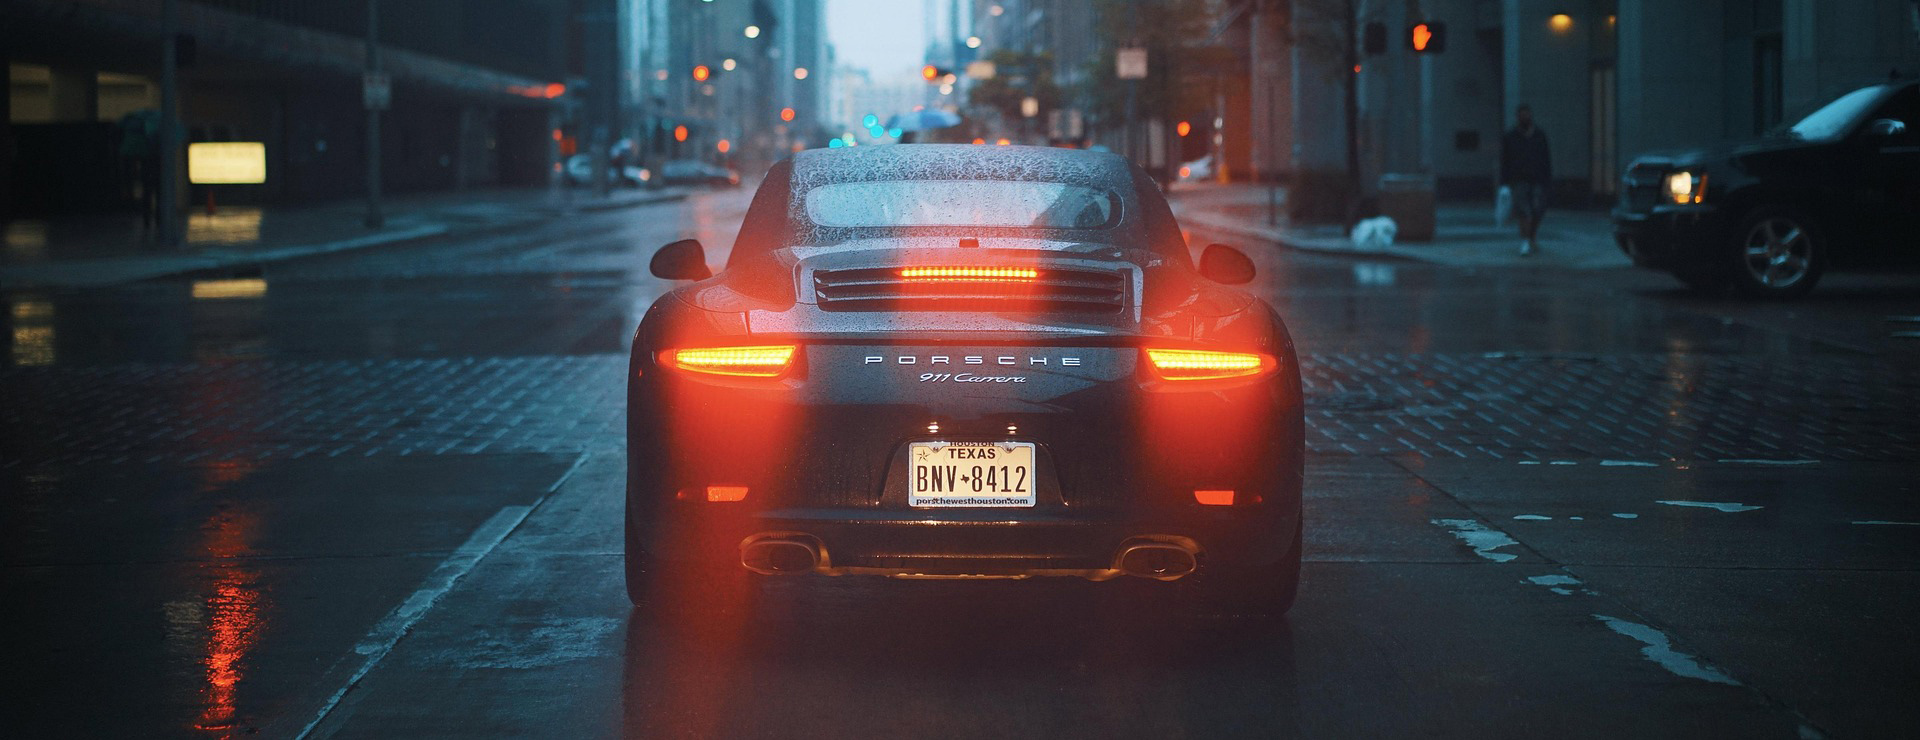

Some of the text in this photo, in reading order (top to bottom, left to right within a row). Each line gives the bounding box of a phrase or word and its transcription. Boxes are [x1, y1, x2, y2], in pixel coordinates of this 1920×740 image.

[865, 356, 1081, 366] PORSCHE
[919, 373, 1026, 383] 911 Carrera
[948, 448, 996, 459] TEXAS
[916, 497, 1028, 505] porschewesthouston.com
